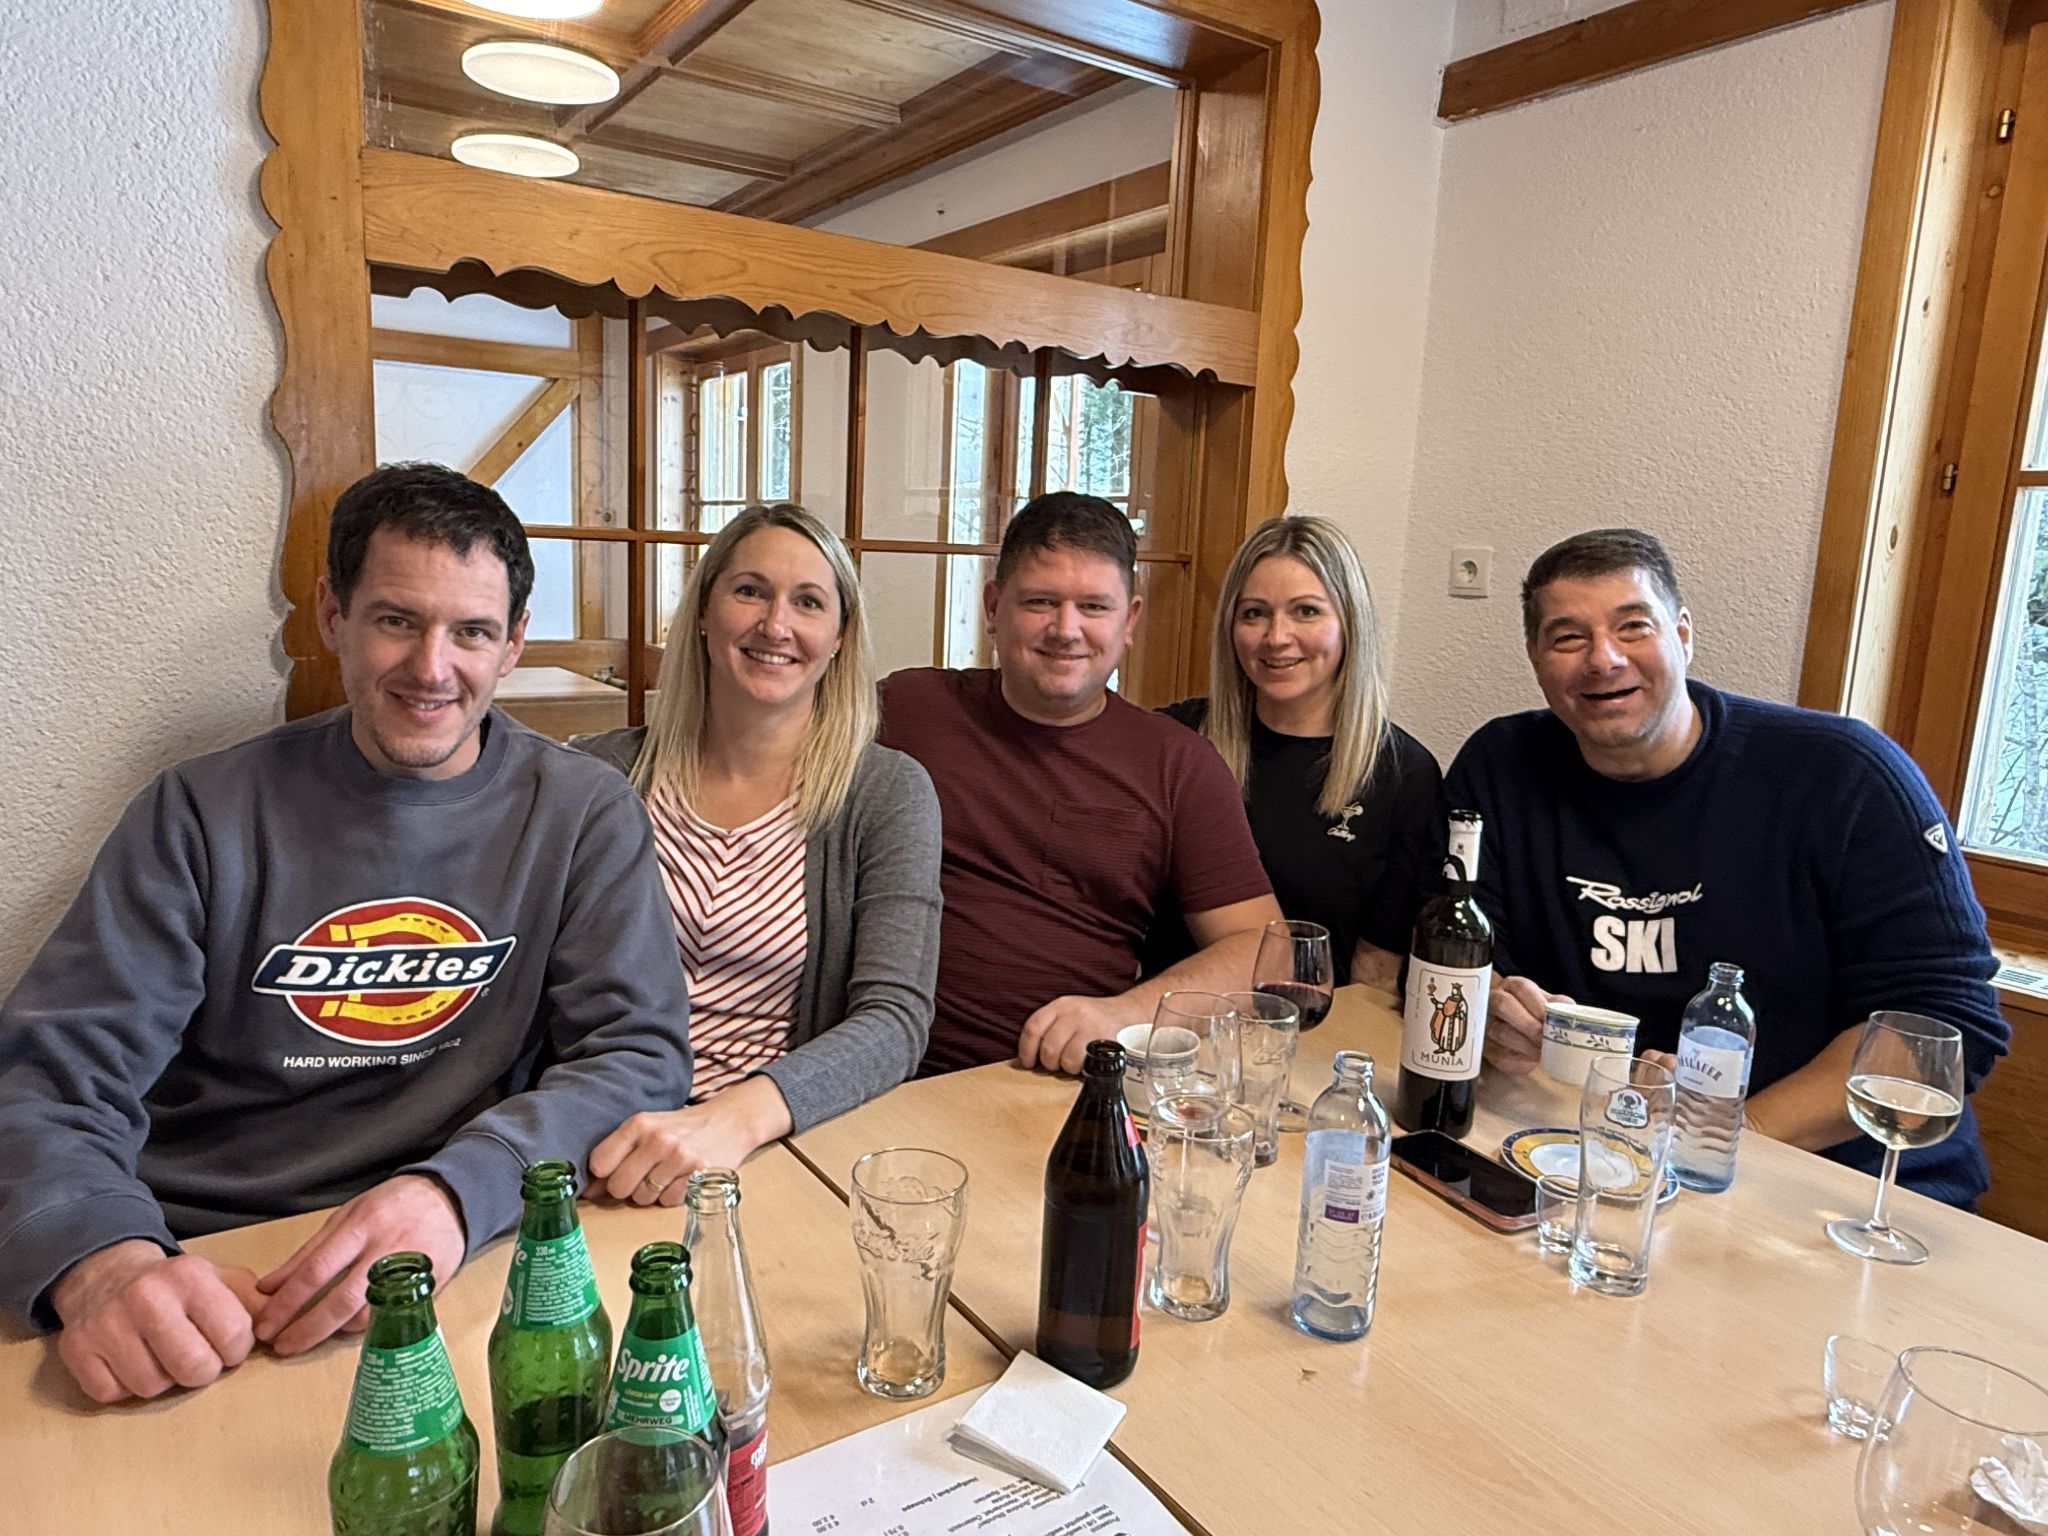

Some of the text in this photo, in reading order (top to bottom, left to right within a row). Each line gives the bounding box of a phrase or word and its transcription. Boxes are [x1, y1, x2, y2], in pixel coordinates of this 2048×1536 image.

[1565, 876, 1703, 914] Rossignol
[1590, 915, 1678, 973] SKI
[275, 953, 494, 986] Dickies
[283, 1056, 325, 1068] HARD
[328, 1055, 397, 1068] WORKING
[1420, 1052, 1464, 1067] MUNIA
[617, 1347, 689, 1382] Sprite
[623, 1412, 673, 1425] MEHRWEG
